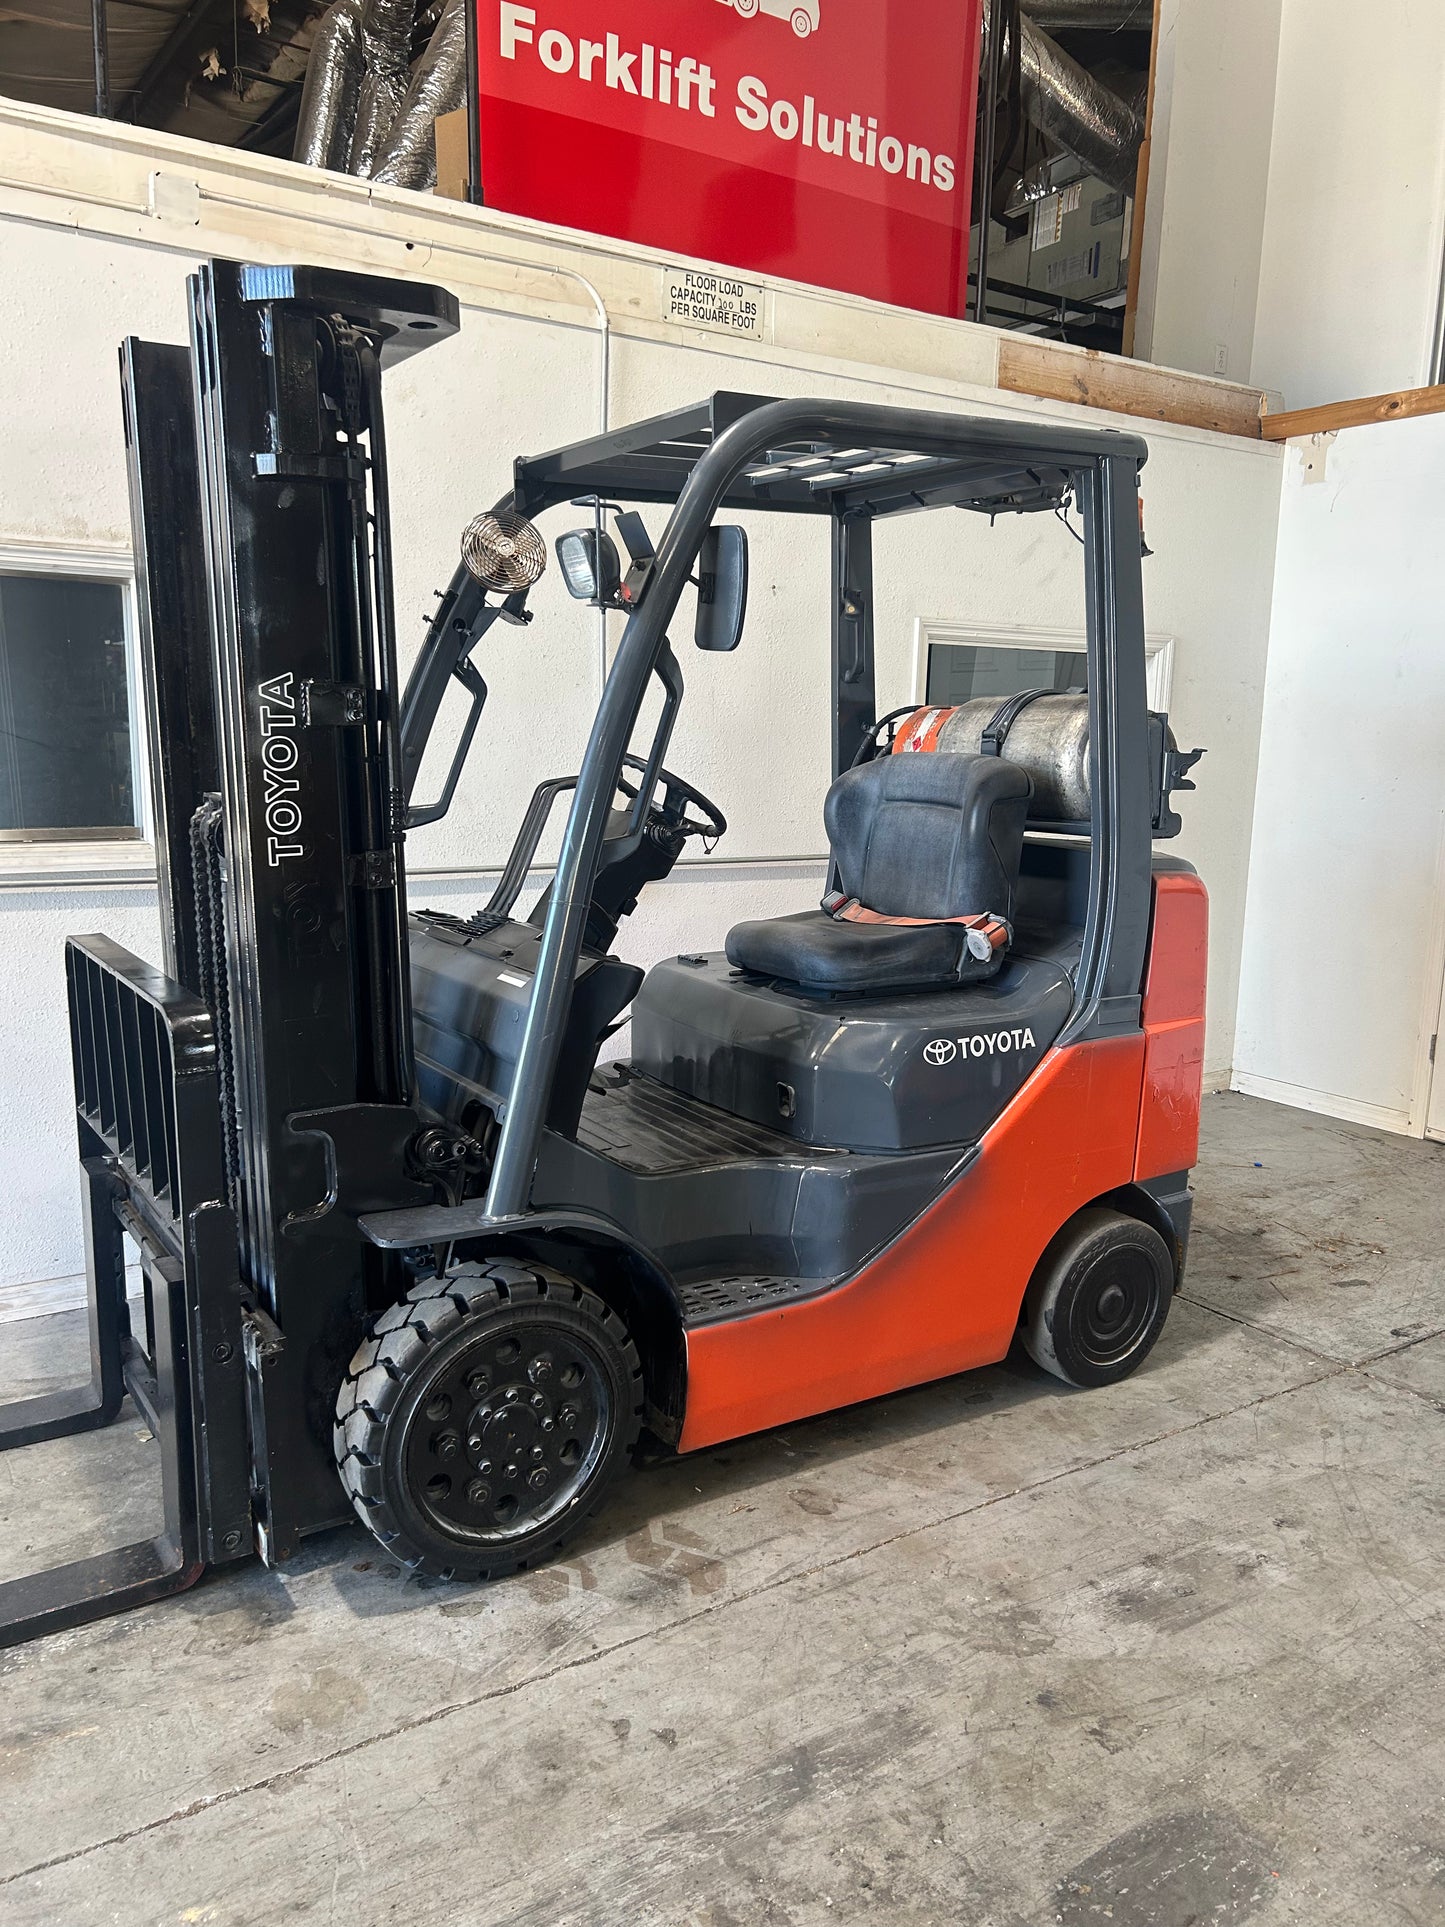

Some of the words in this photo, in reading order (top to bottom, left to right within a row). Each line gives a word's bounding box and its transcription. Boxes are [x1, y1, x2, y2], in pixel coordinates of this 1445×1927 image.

[500, 3, 716, 118] Forklift
[735, 76, 955, 192] Solutions
[670, 285, 716, 306] CAPACITY
[740, 300, 757, 315] LBS
[685, 274, 717, 292] FLOOR
[719, 281, 743, 297] LOAD
[671, 301, 690, 316] PER
[692, 305, 730, 324] SQUARE
[732, 313, 756, 330] FOOT
[258, 671, 304, 867] TOYOTA
[957, 1027, 1036, 1059] TOYOTA
